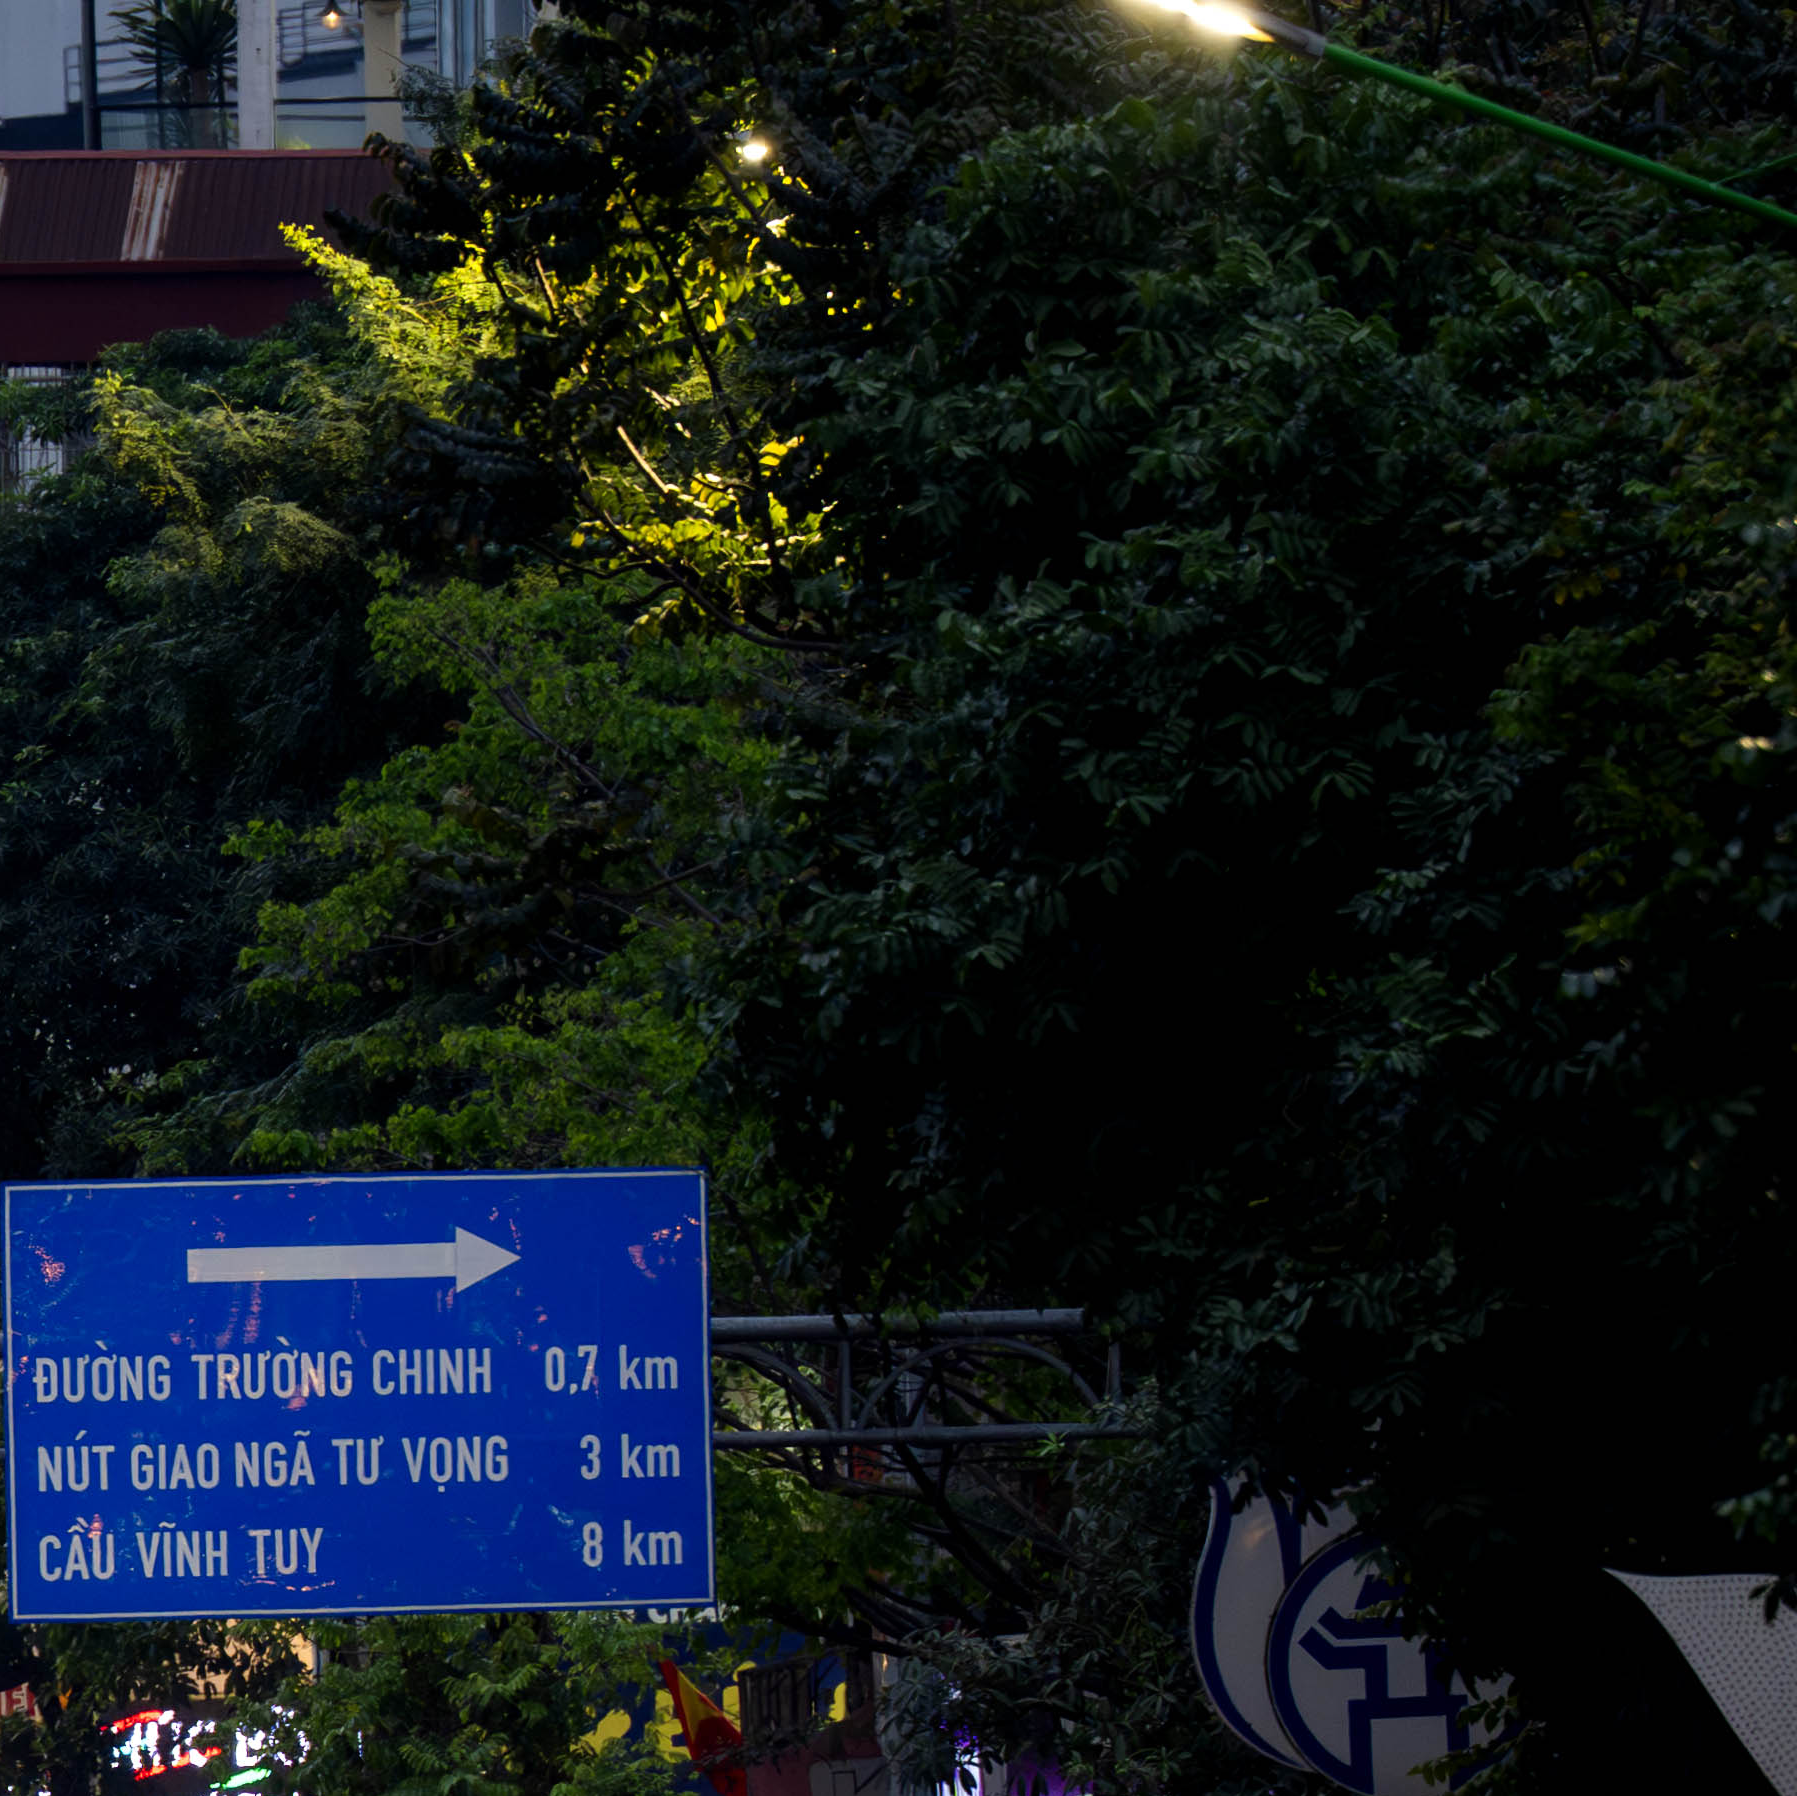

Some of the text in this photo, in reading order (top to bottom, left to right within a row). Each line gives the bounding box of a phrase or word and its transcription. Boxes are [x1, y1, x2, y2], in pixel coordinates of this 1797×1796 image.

[32, 1336, 679, 1404] ĐƯỜNG TRƯỜNG CHINH 0,7 km
[37, 1430, 681, 1493] NÚT GIAO NGÃ TƯ VỌNG 3 km
[38, 1517, 684, 1582] CẦU VĨNH TUY 8 km
